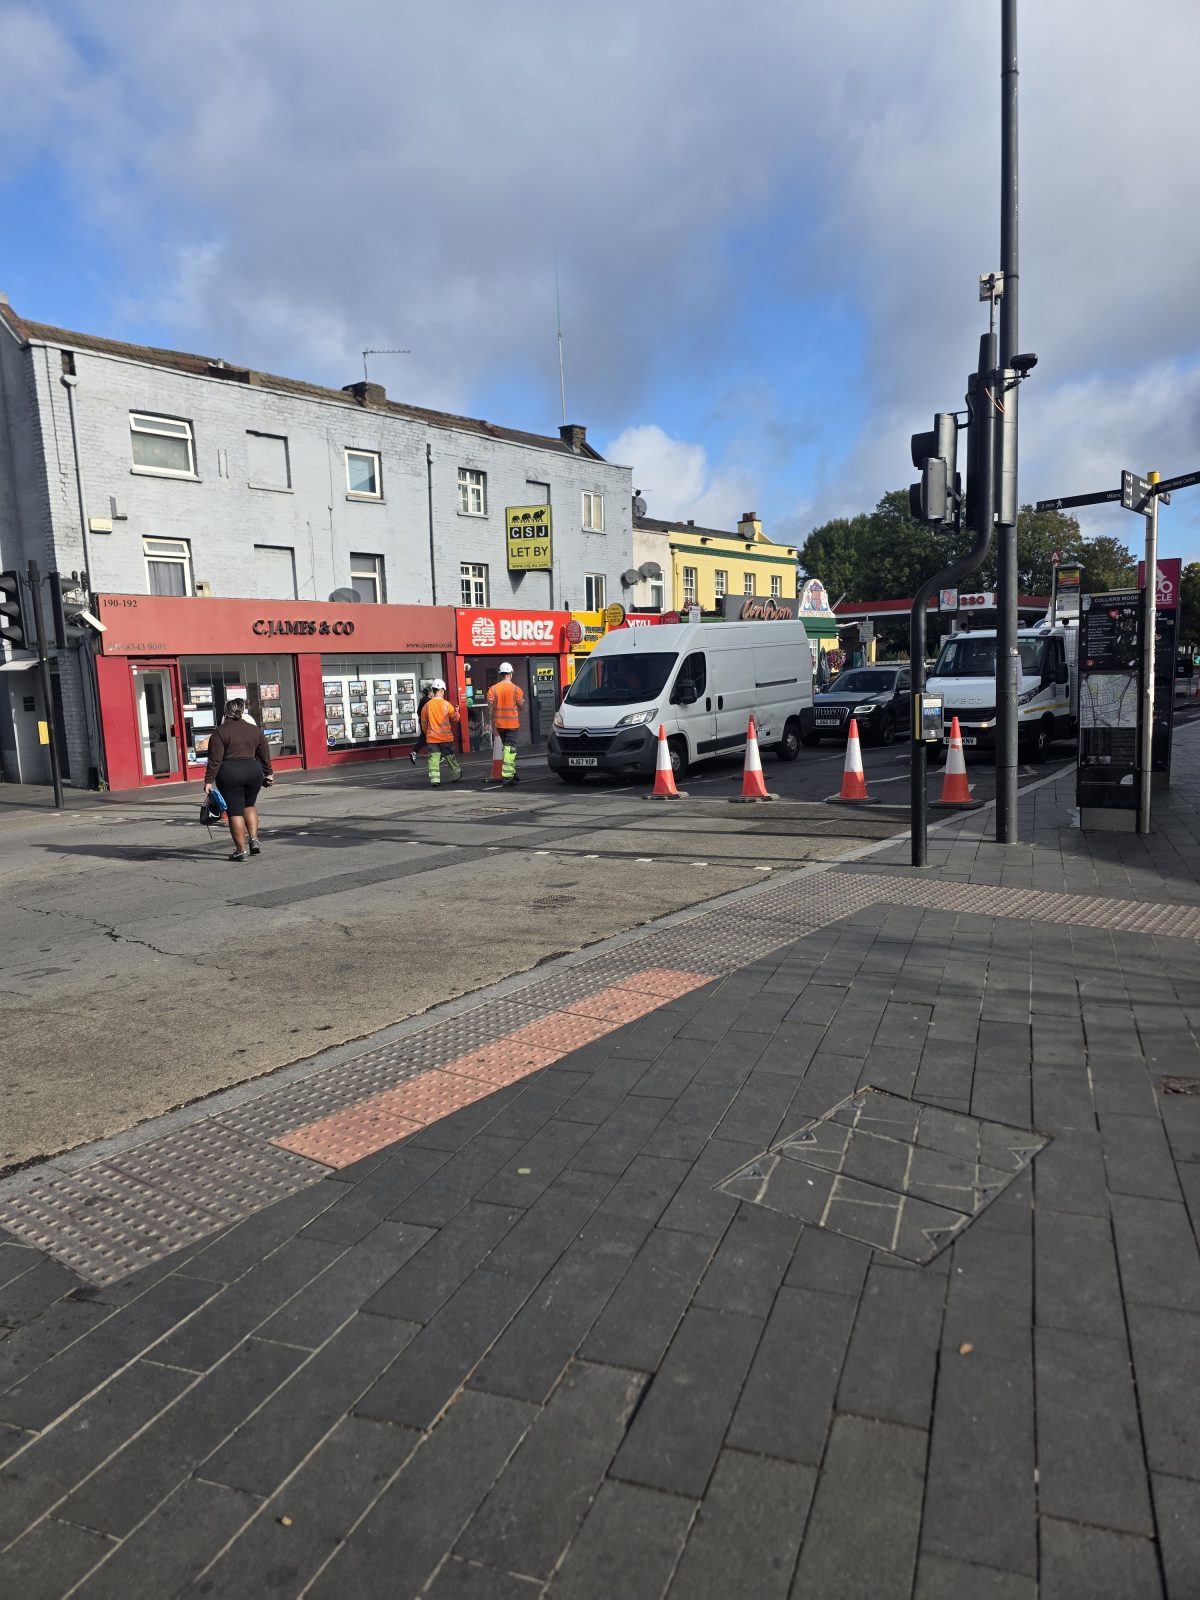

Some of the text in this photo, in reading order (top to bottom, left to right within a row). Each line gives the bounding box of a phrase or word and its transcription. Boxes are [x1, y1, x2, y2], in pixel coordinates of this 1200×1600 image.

[511, 546, 549, 558] LET BY
[1051, 552, 1060, 561] A
[103, 599, 138, 608] 190-192
[318, 620, 331, 636] &
[332, 620, 355, 636] CO
[499, 619, 555, 641] BURGZ
